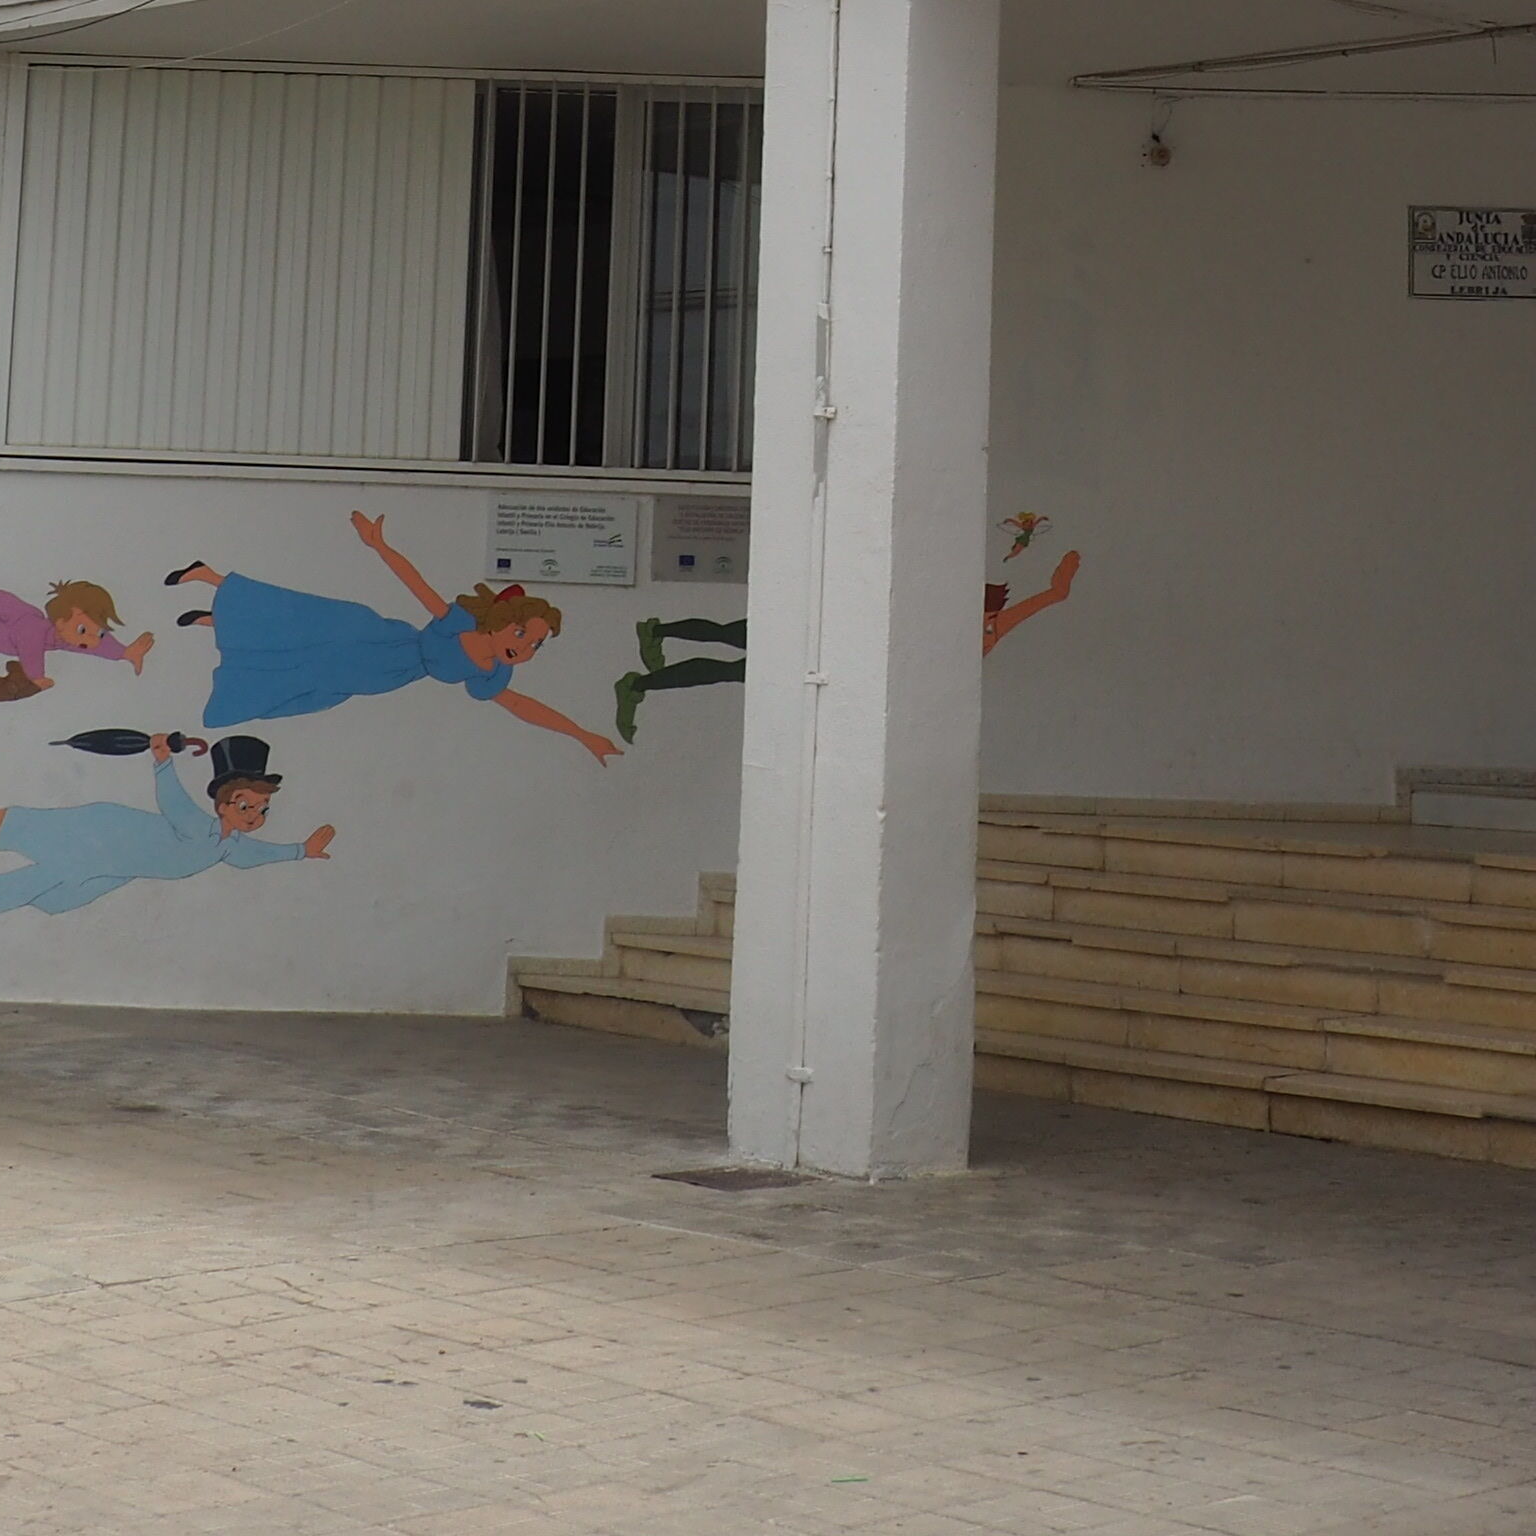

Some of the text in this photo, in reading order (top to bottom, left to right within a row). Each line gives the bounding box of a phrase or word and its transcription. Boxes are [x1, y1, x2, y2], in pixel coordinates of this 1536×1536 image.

[1458, 211, 1501, 225] JUNTA
[1437, 232, 1520, 245] ANDALUCIA
[1450, 264, 1477, 280] ELIO
[1482, 265, 1528, 281] ANTONIO
[1450, 286, 1508, 295] LEBRIJA
